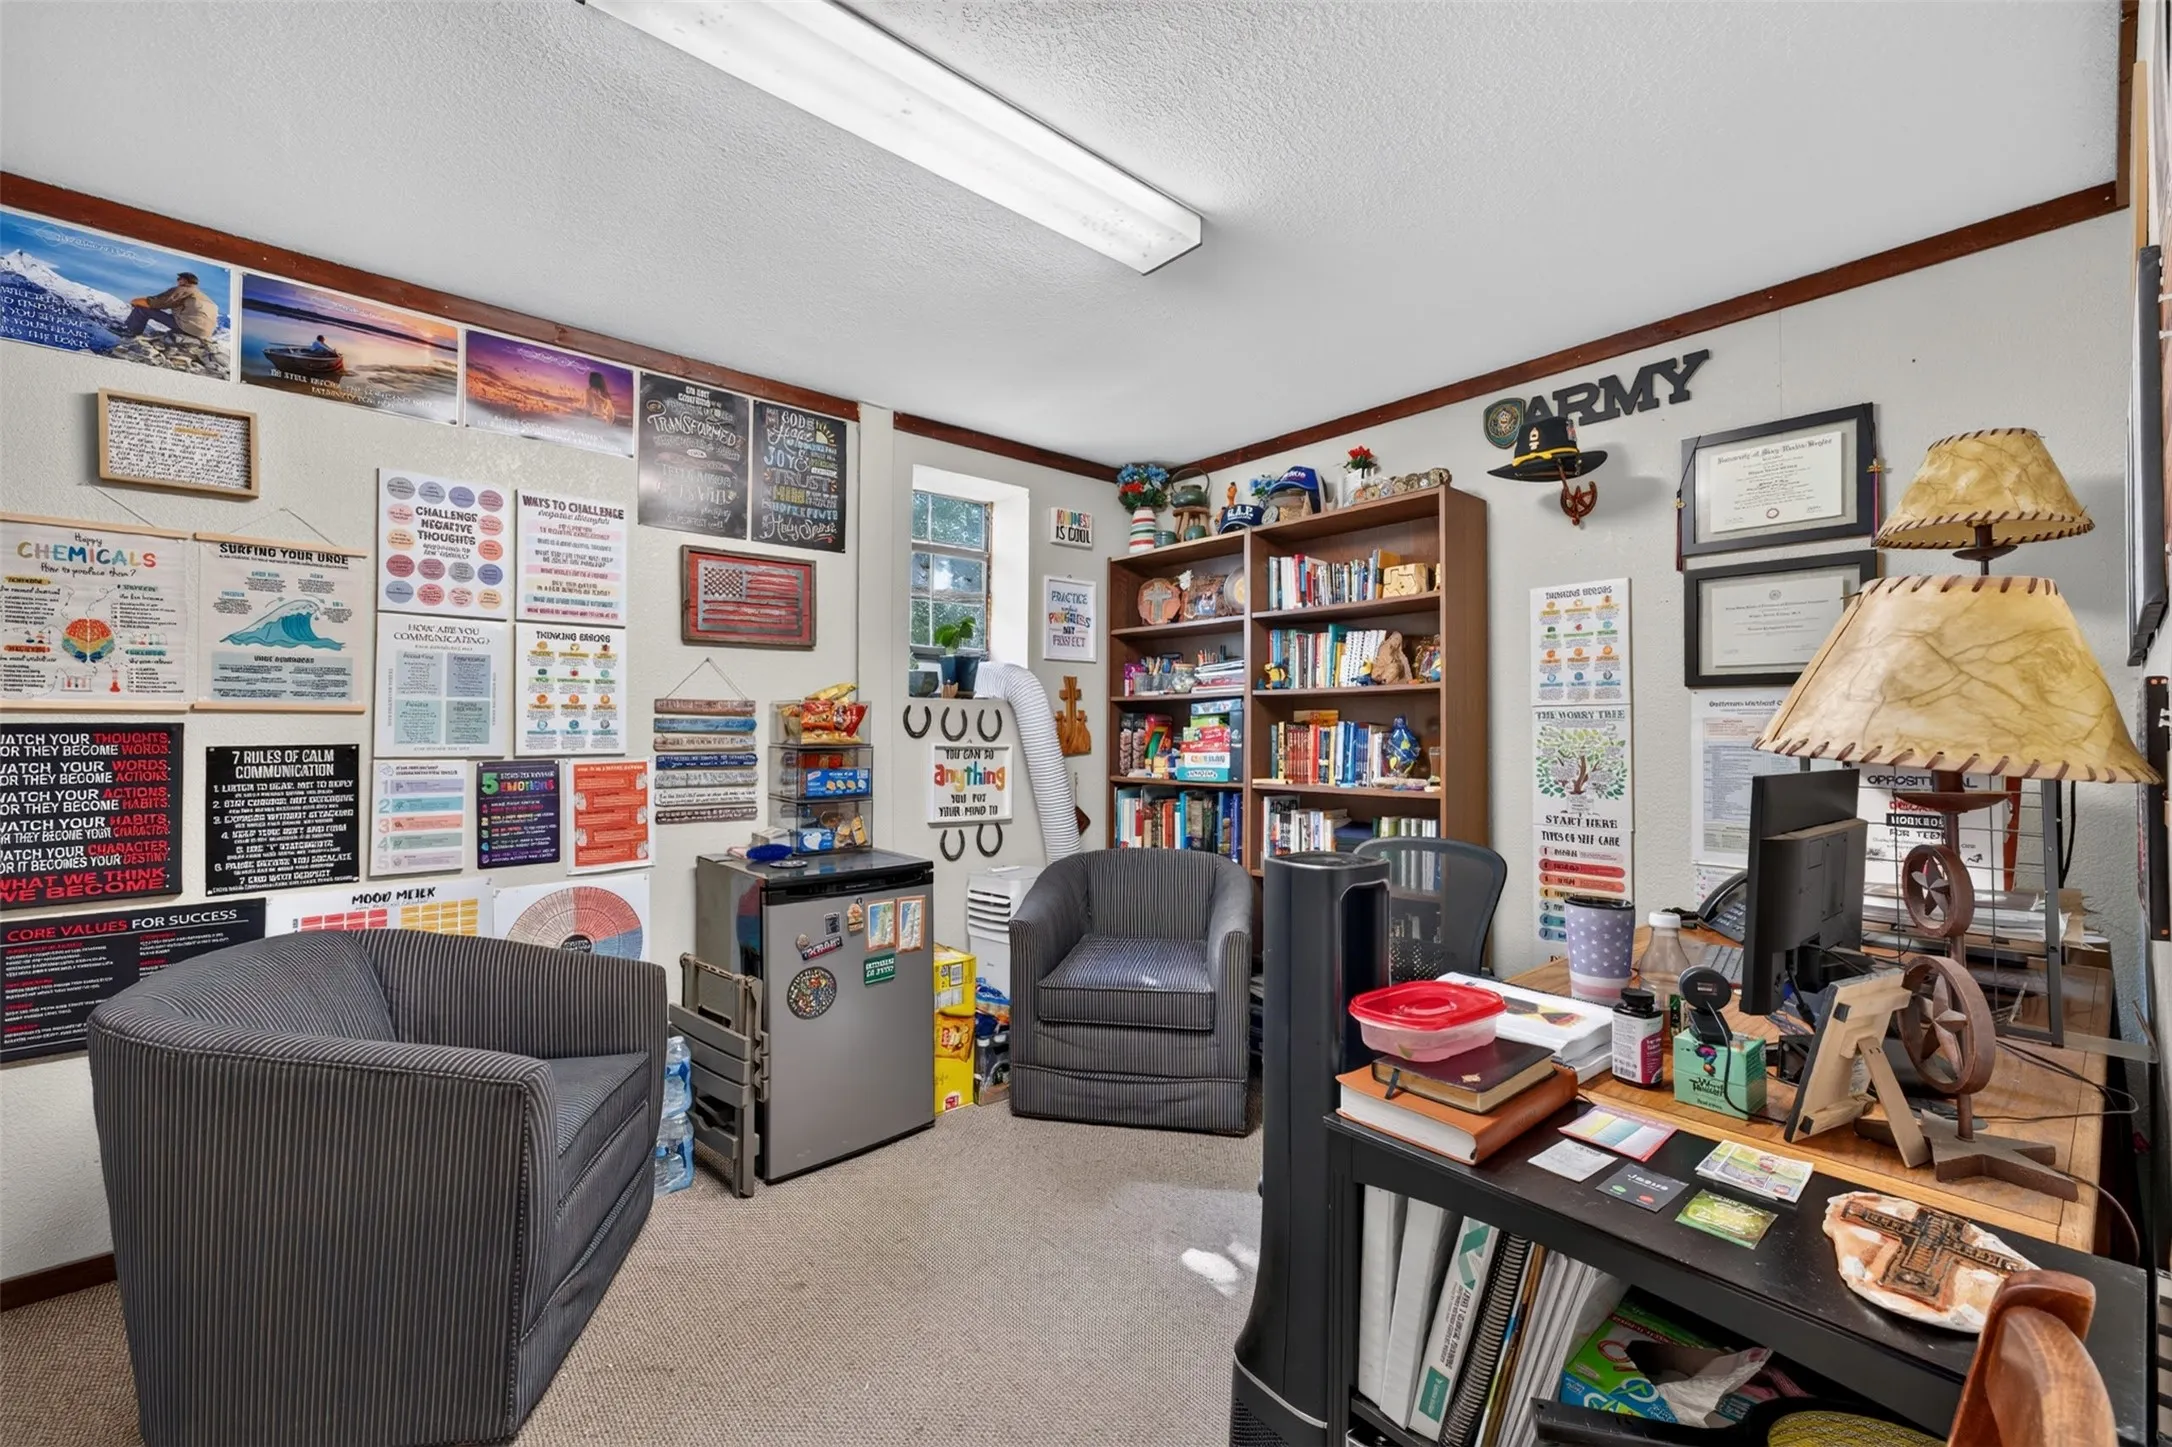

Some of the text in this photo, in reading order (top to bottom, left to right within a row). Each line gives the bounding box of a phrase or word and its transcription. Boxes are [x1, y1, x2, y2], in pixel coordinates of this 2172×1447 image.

[1524, 349, 1710, 426] ARMY
[781, 412, 806, 429] GOD
[415, 506, 478, 523] CHALLENGE
[522, 495, 625, 520] WAYS TO CHALLENGE
[421, 519, 473, 534] NEGATIVE
[417, 530, 476, 546] THOUGHTS
[1056, 526, 1091, 544] IS COOL
[17, 541, 157, 568] CHEMICALS
[220, 542, 276, 558] SURFING
[280, 549, 313, 562] YOUR
[317, 553, 349, 566] URGE
[536, 630, 577, 642] THINKING
[49, 733, 90, 746] YOUR
[0, 745, 20, 758] OR
[24, 745, 60, 758] THEY
[62, 744, 119, 757] BECOME
[232, 749, 334, 764] 7 RULES OF CALM
[945, 749, 960, 760] YOU
[963, 749, 980, 760] CAN
[60, 761, 104, 773] YOUR
[235, 764, 334, 779] COMMUNICATION
[0, 774, 19, 787] OR
[22, 774, 56, 786] THEY
[59, 772, 113, 785] BECOME
[481, 772, 499, 795] 5
[934, 761, 1005, 792] anything
[55, 789, 99, 802] YOUR
[951, 794, 966, 803] YOU
[0, 804, 21, 816] OR
[24, 803, 59, 815] THEY
[62, 800, 120, 813] BECOME
[378, 798, 390, 813] 2
[939, 806, 960, 817] YOUR
[989, 805, 998, 815] TO
[59, 817, 105, 830] YOUR
[1545, 814, 1618, 829] START HERE
[14, 832, 39, 844] THEY
[42, 830, 83, 843] BECOME
[86, 828, 111, 840] YOUR
[46, 846, 84, 858] YOUR
[18, 861, 28, 872] IT
[31, 857, 87, 871] BECOMES
[91, 854, 121, 867] YOUR
[63, 872, 97, 885] WE
[0, 889, 37, 903] WE
[352, 891, 392, 905] MOOD
[7, 909, 237, 943] CORE VALUES FOR SUCCESS
